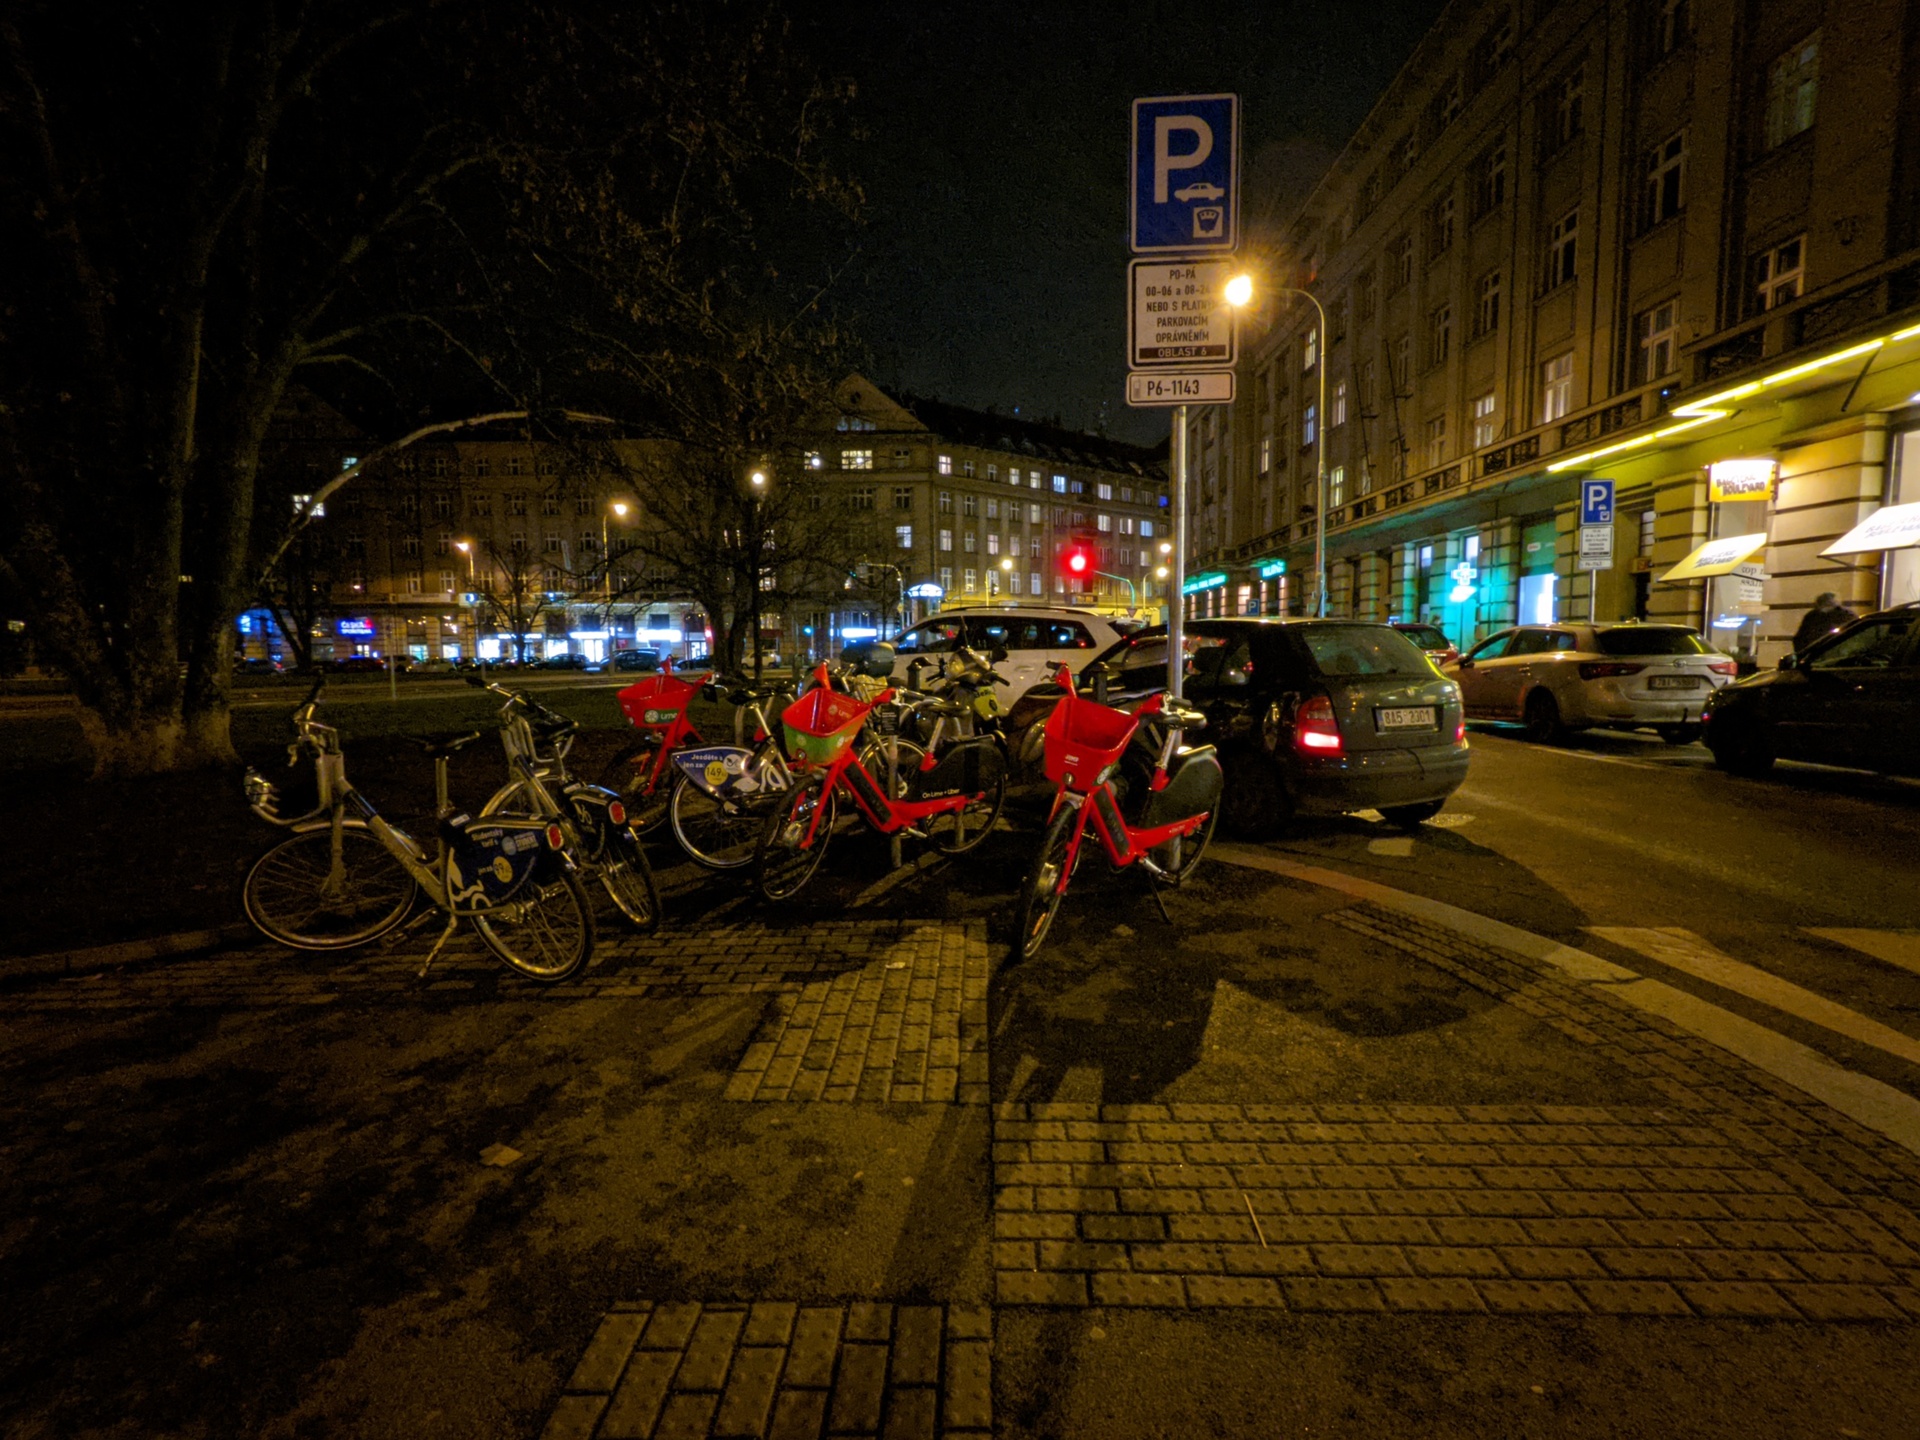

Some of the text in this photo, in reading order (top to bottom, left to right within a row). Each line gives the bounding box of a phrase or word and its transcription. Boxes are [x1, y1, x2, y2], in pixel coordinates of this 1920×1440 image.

[1153, 115, 1214, 204] P
[1169, 267, 1196, 280] PO-PÁ
[1145, 286, 1172, 297] 00-06
[1175, 288, 1181, 296] a
[1146, 302, 1169, 312] NEBO
[1172, 301, 1178, 311] S
[1156, 316, 1209, 328] PARKOVACÍM
[1155, 330, 1209, 343] OPRÁVNĚNÍM
[1158, 347, 1207, 357] OBLAST 6
[1147, 380, 1200, 396] P6-1143
[1588, 485, 1608, 511] P
[1248, 601, 1257, 613] P
[1384, 709, 1431, 725] 8A5 2301
[706, 767, 722, 777] 149
